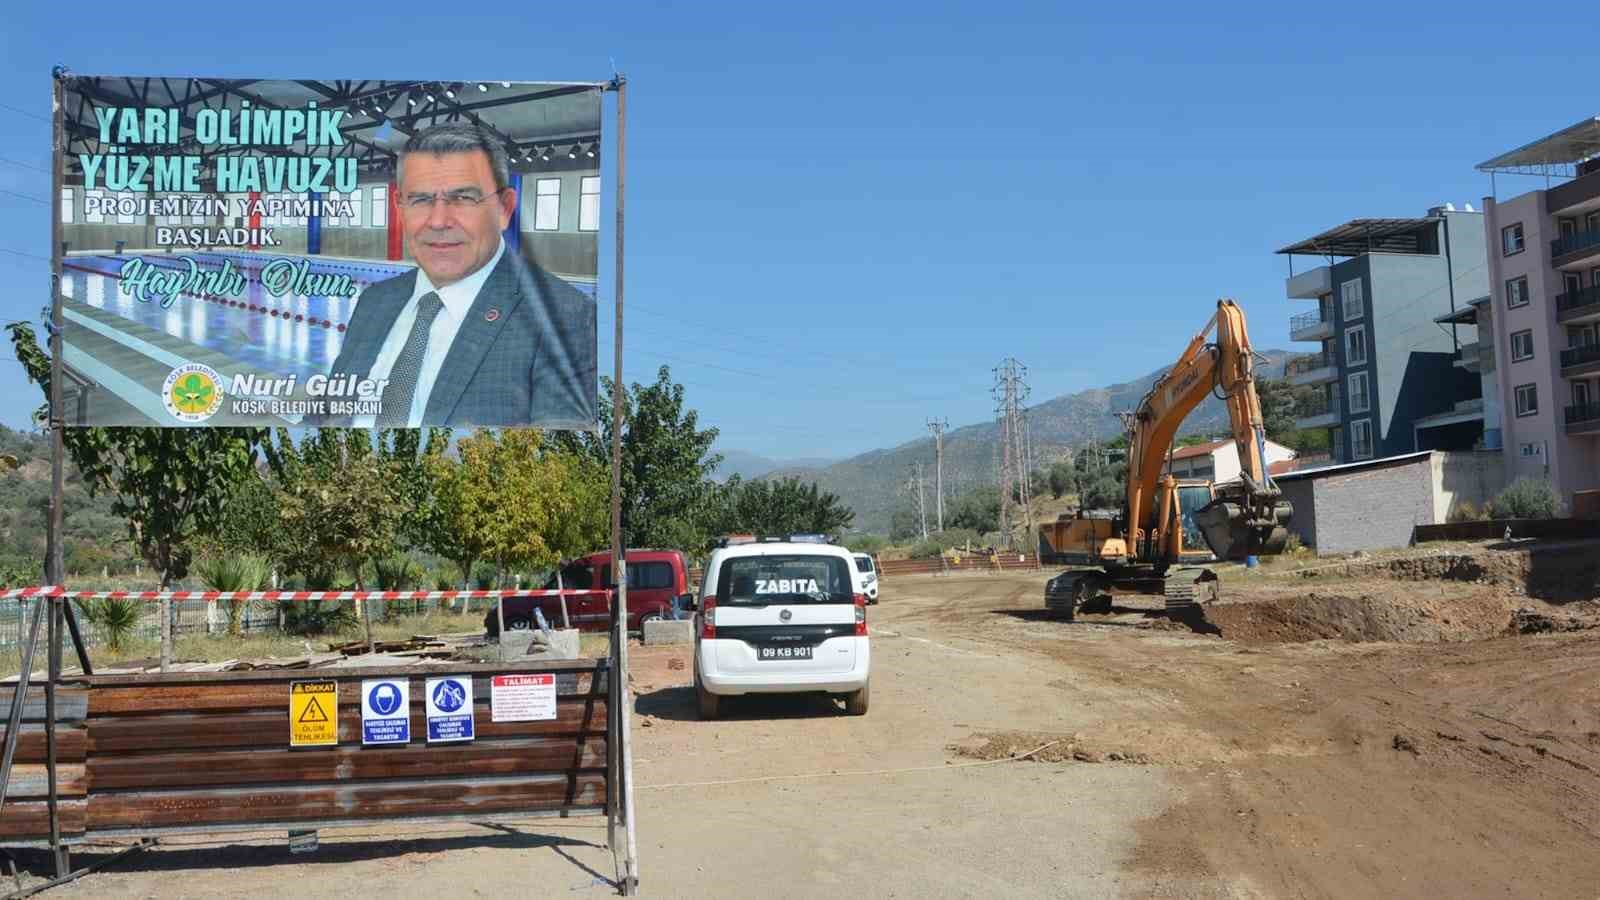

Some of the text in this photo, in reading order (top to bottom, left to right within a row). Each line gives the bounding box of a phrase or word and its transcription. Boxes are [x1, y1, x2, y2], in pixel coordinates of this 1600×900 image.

[94, 100, 346, 146] YARI OLİMPİK
[79, 146, 359, 193] YÜZME HAVUZU
[84, 195, 355, 217] PROJEMİZİN YAPIMINA
[156, 227, 282, 250] BAŞLADIK.
[230, 372, 390, 397] Nuri Güler
[232, 399, 384, 416] KÖŞK BELEDİYE BAŞKANI
[755, 578, 819, 594] ZABITA
[762, 646, 811, 657] 09 KB 901
